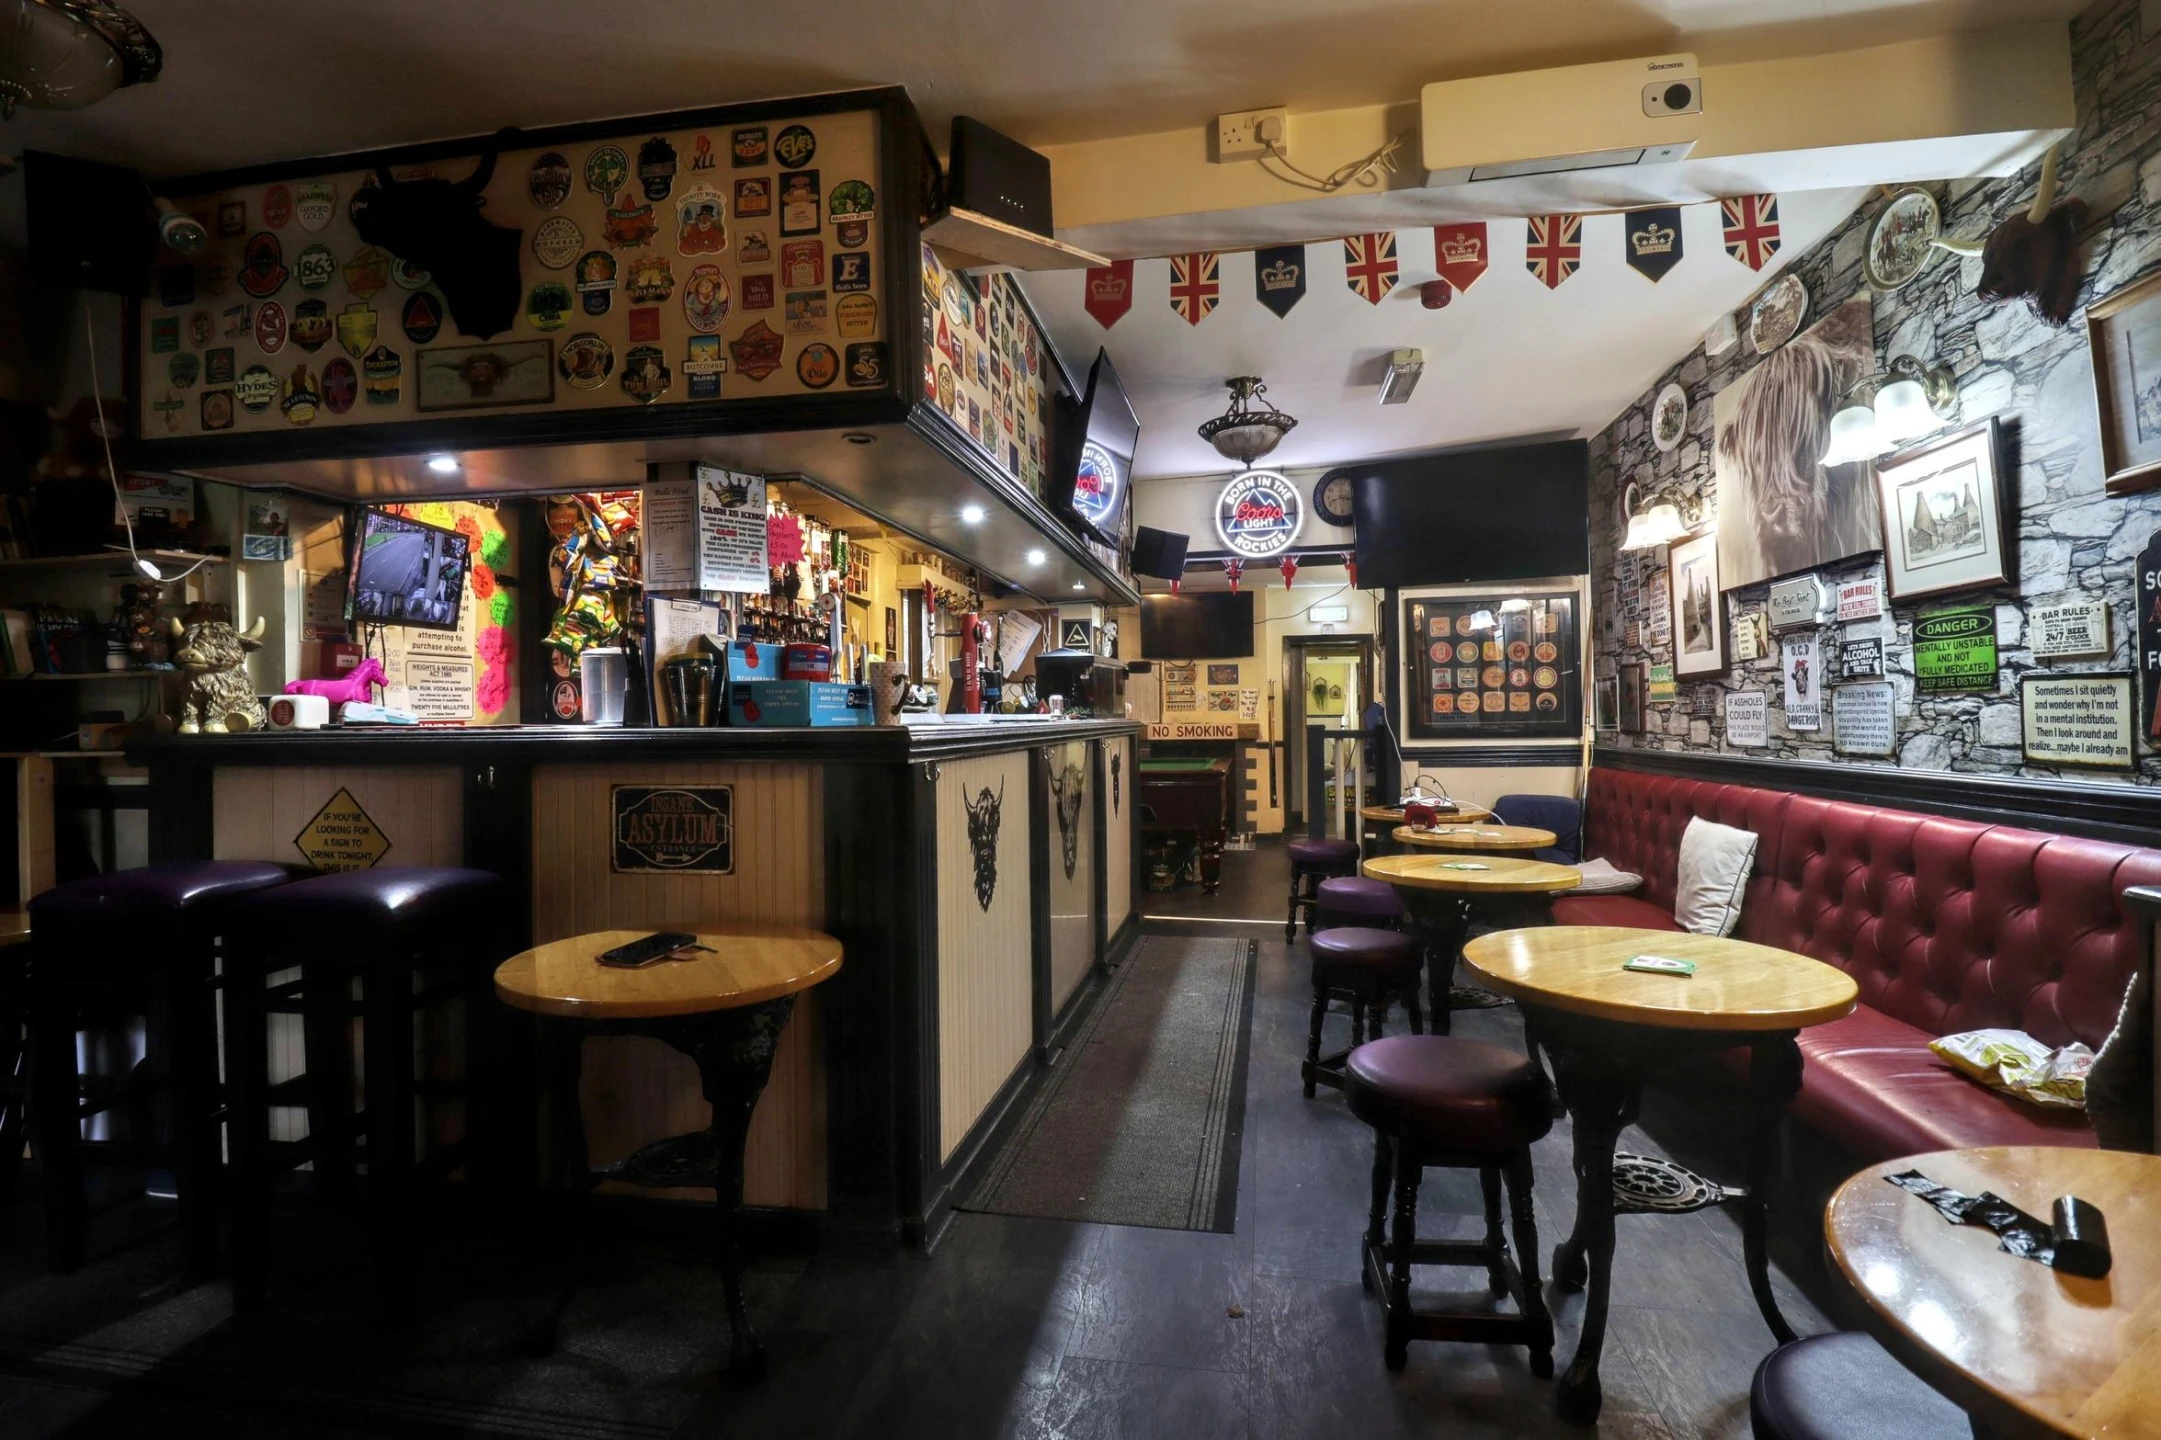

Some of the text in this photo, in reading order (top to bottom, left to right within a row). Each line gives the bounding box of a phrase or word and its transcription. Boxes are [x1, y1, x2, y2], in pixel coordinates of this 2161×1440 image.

[300, 204, 329, 214] OXFORD
[303, 211, 324, 220] GOLD
[294, 258, 335, 277] 1863
[686, 362, 724, 370] BUTCOMBE
[236, 380, 278, 393] HYDES
[1224, 476, 1293, 505] BORN IN THE
[701, 505, 766, 521] CASH IS KING
[1236, 502, 1283, 520] Coors
[1244, 518, 1274, 528] LIGHT
[1234, 532, 1287, 552] ROCKIES
[1843, 585, 1873, 599] BAR RULES
[2041, 610, 2060, 620] BAR
[2062, 607, 2091, 616] RULES
[1927, 618, 1979, 635] DANGER
[417, 632, 463, 642] attempting to
[2045, 626, 2088, 642] 24/7 BEER
[412, 642, 468, 652] purchase alcohol.
[1915, 637, 1994, 653] MENTALLY UNSTABLE
[1842, 647, 1880, 661] ALCOHOL
[1936, 651, 1971, 663] AND NOT
[1921, 663, 1990, 676] FULLY MEDICATED
[1937, 677, 1956, 687] SAFE
[1956, 675, 1993, 686] DISTANCE
[1837, 689, 1887, 701] Breaking News:
[2034, 685, 2075, 696] Sometimes
[2079, 685, 2090, 696] sit
[2090, 684, 2117, 697] quietly
[1727, 696, 1764, 707] IF ASSHOLES
[2034, 700, 2119, 712] and wonder why I'm not
[1729, 710, 1751, 721] COULD
[2036, 713, 2118, 725] in a mental institution.
[1152, 725, 1234, 737] NO SMOKING
[1736, 724, 1750, 732] PLACE
[1750, 724, 1766, 732] WOULD
[2036, 727, 2053, 738] Then
[2058, 728, 2074, 738] look
[2074, 728, 2101, 739] around
[2102, 729, 2118, 740] and
[2085, 743, 2115, 757] already
[2115, 746, 2128, 756] am
[650, 795, 695, 812] INSANE
[323, 812, 362, 822] IF YOU'RE
[316, 825, 370, 836] LOOKING FOR
[627, 812, 719, 844] ASYLUM
[330, 838, 351, 847] SIGN
[351, 840, 362, 848] TO
[650, 845, 697, 853] ENTRANCE
[310, 850, 374, 862] DRINK TONIGHT,
[323, 863, 341, 873] THIS
[342, 864, 351, 872] IS
